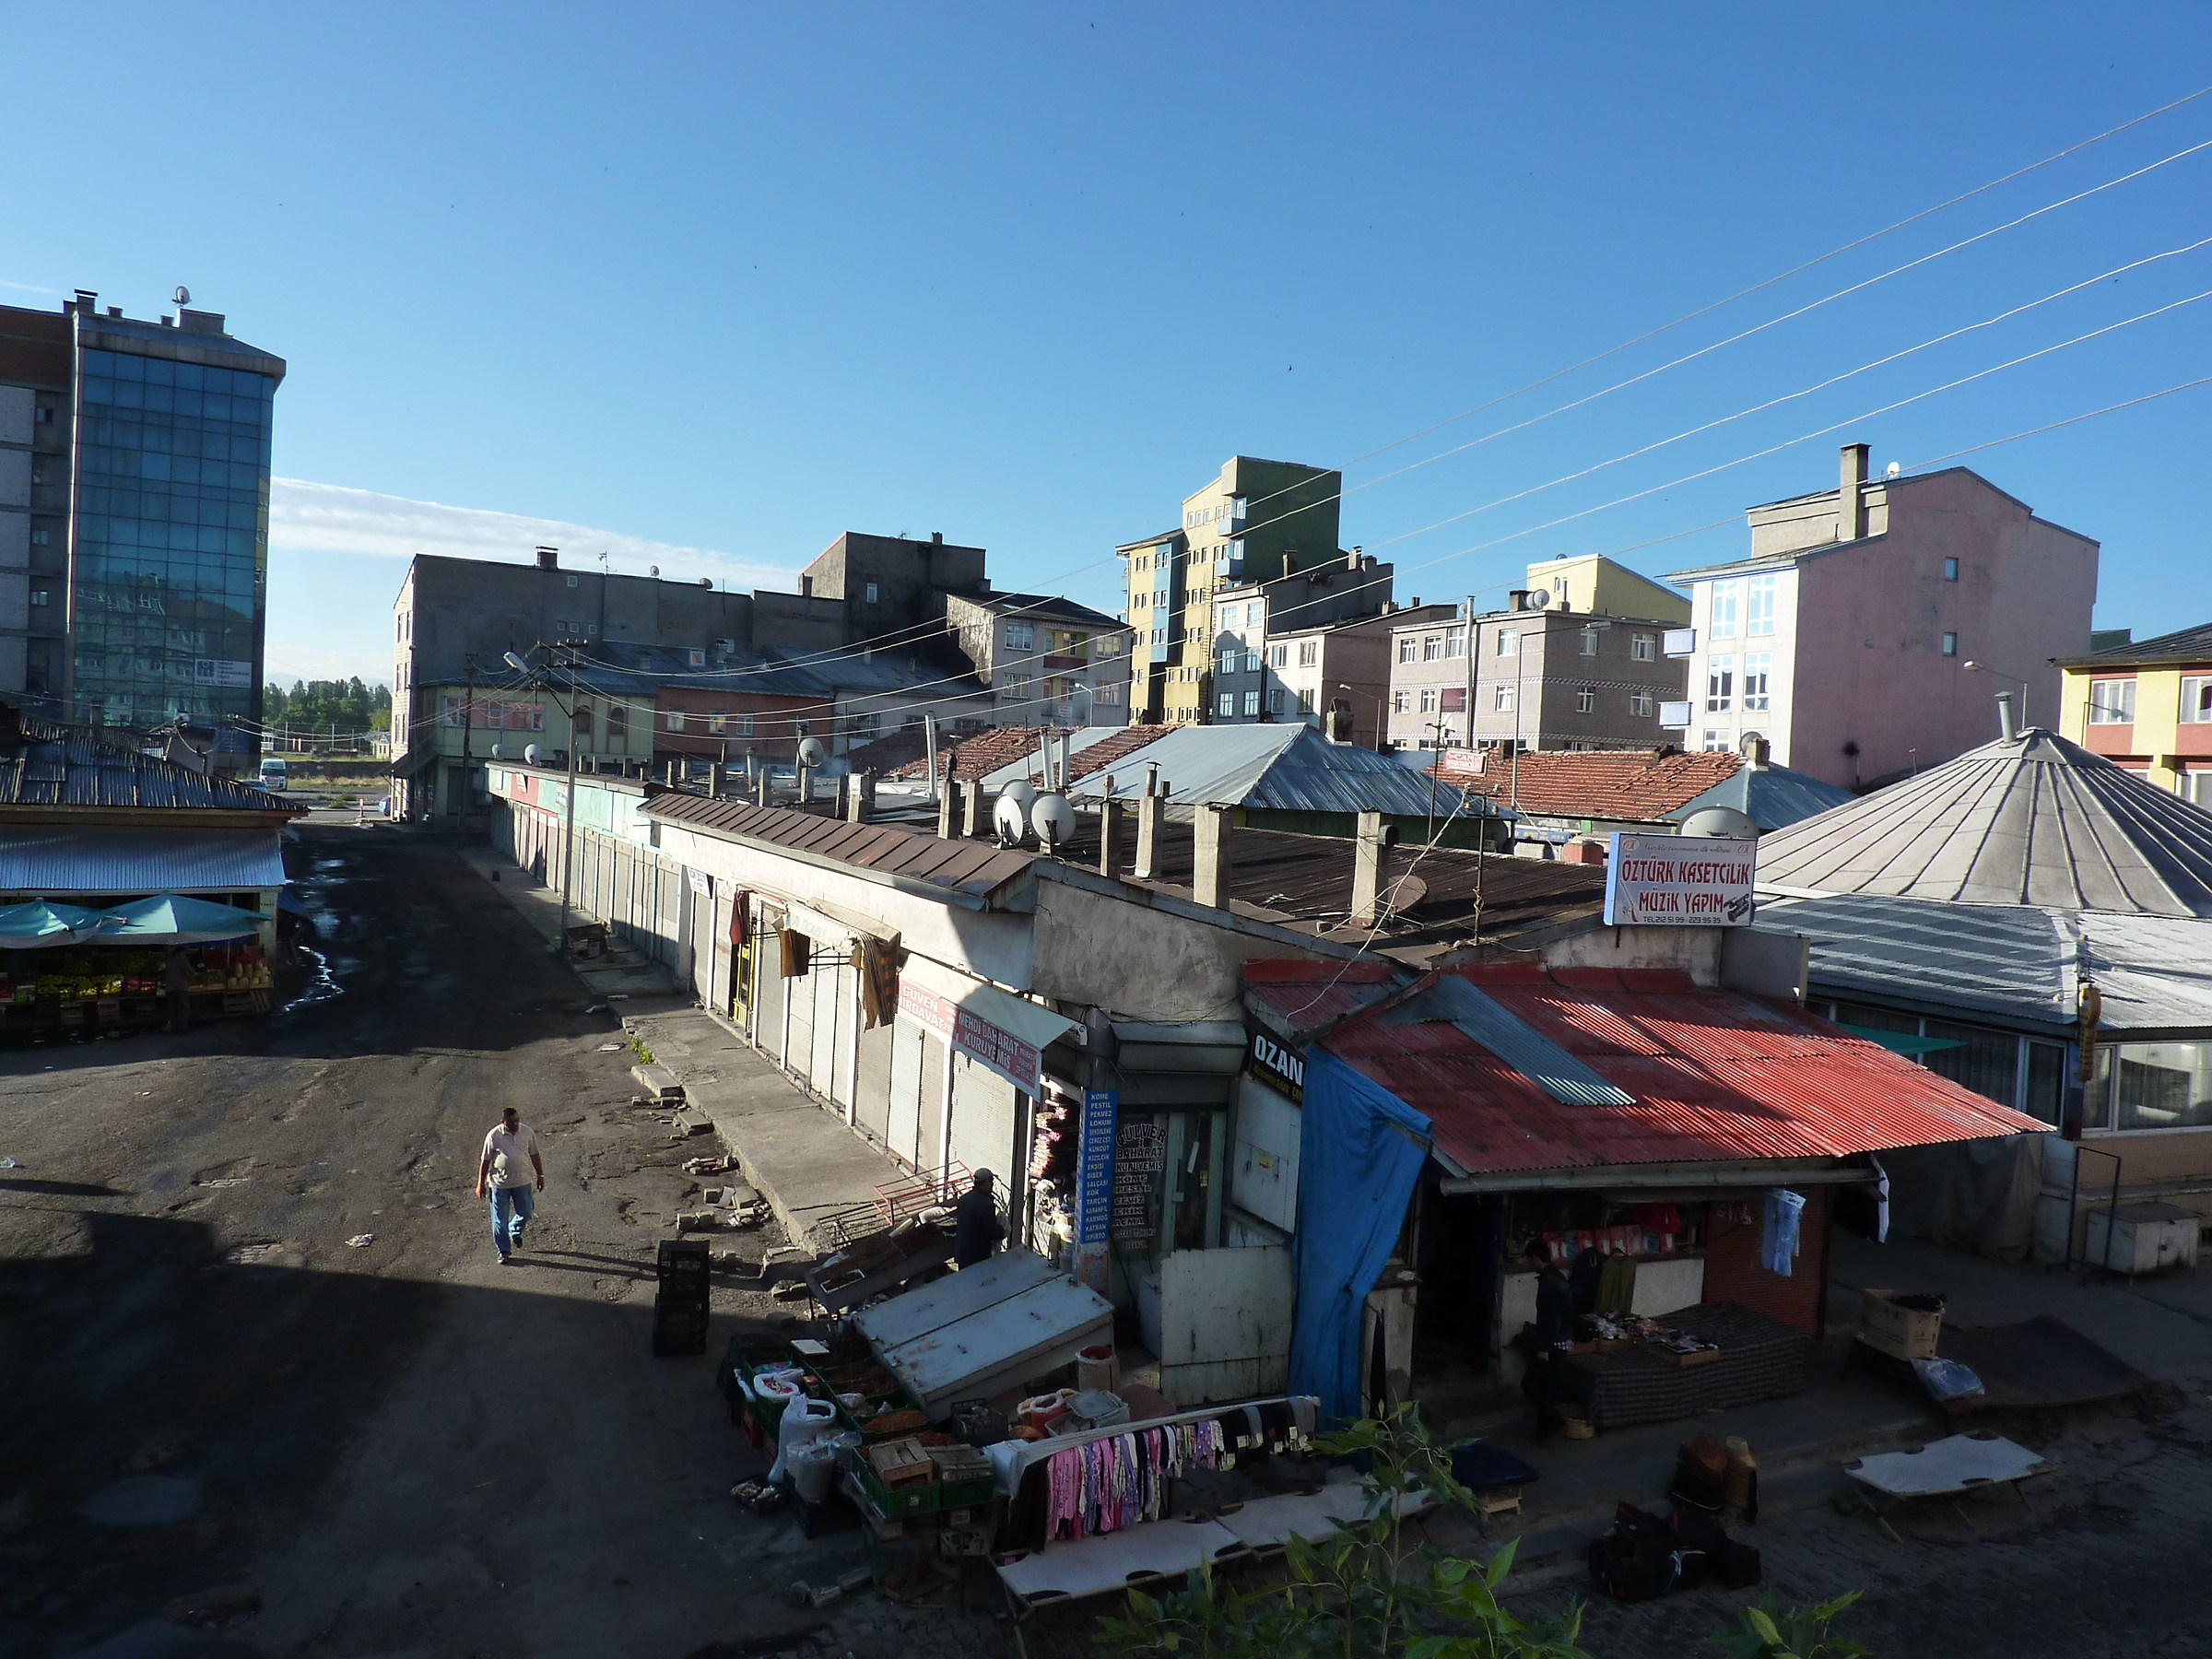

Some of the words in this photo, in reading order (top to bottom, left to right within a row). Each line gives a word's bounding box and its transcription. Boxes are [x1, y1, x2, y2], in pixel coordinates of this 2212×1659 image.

[1621, 854, 1676, 885] ÖZTÜRK
[1678, 860, 1750, 885] KASETCİLİK
[1639, 888, 1679, 912] MÜZİK
[1684, 892, 1724, 914] YAPIM
[903, 984, 938, 1013] GÜVEN
[959, 1011, 982, 1035] MEHDİ
[982, 1023, 1019, 1056] BAHARAT
[1254, 1034, 1303, 1087] OZAN
[1090, 1101, 1112, 1110] PESTİL
[1115, 1147, 1164, 1159] BAHARAT
